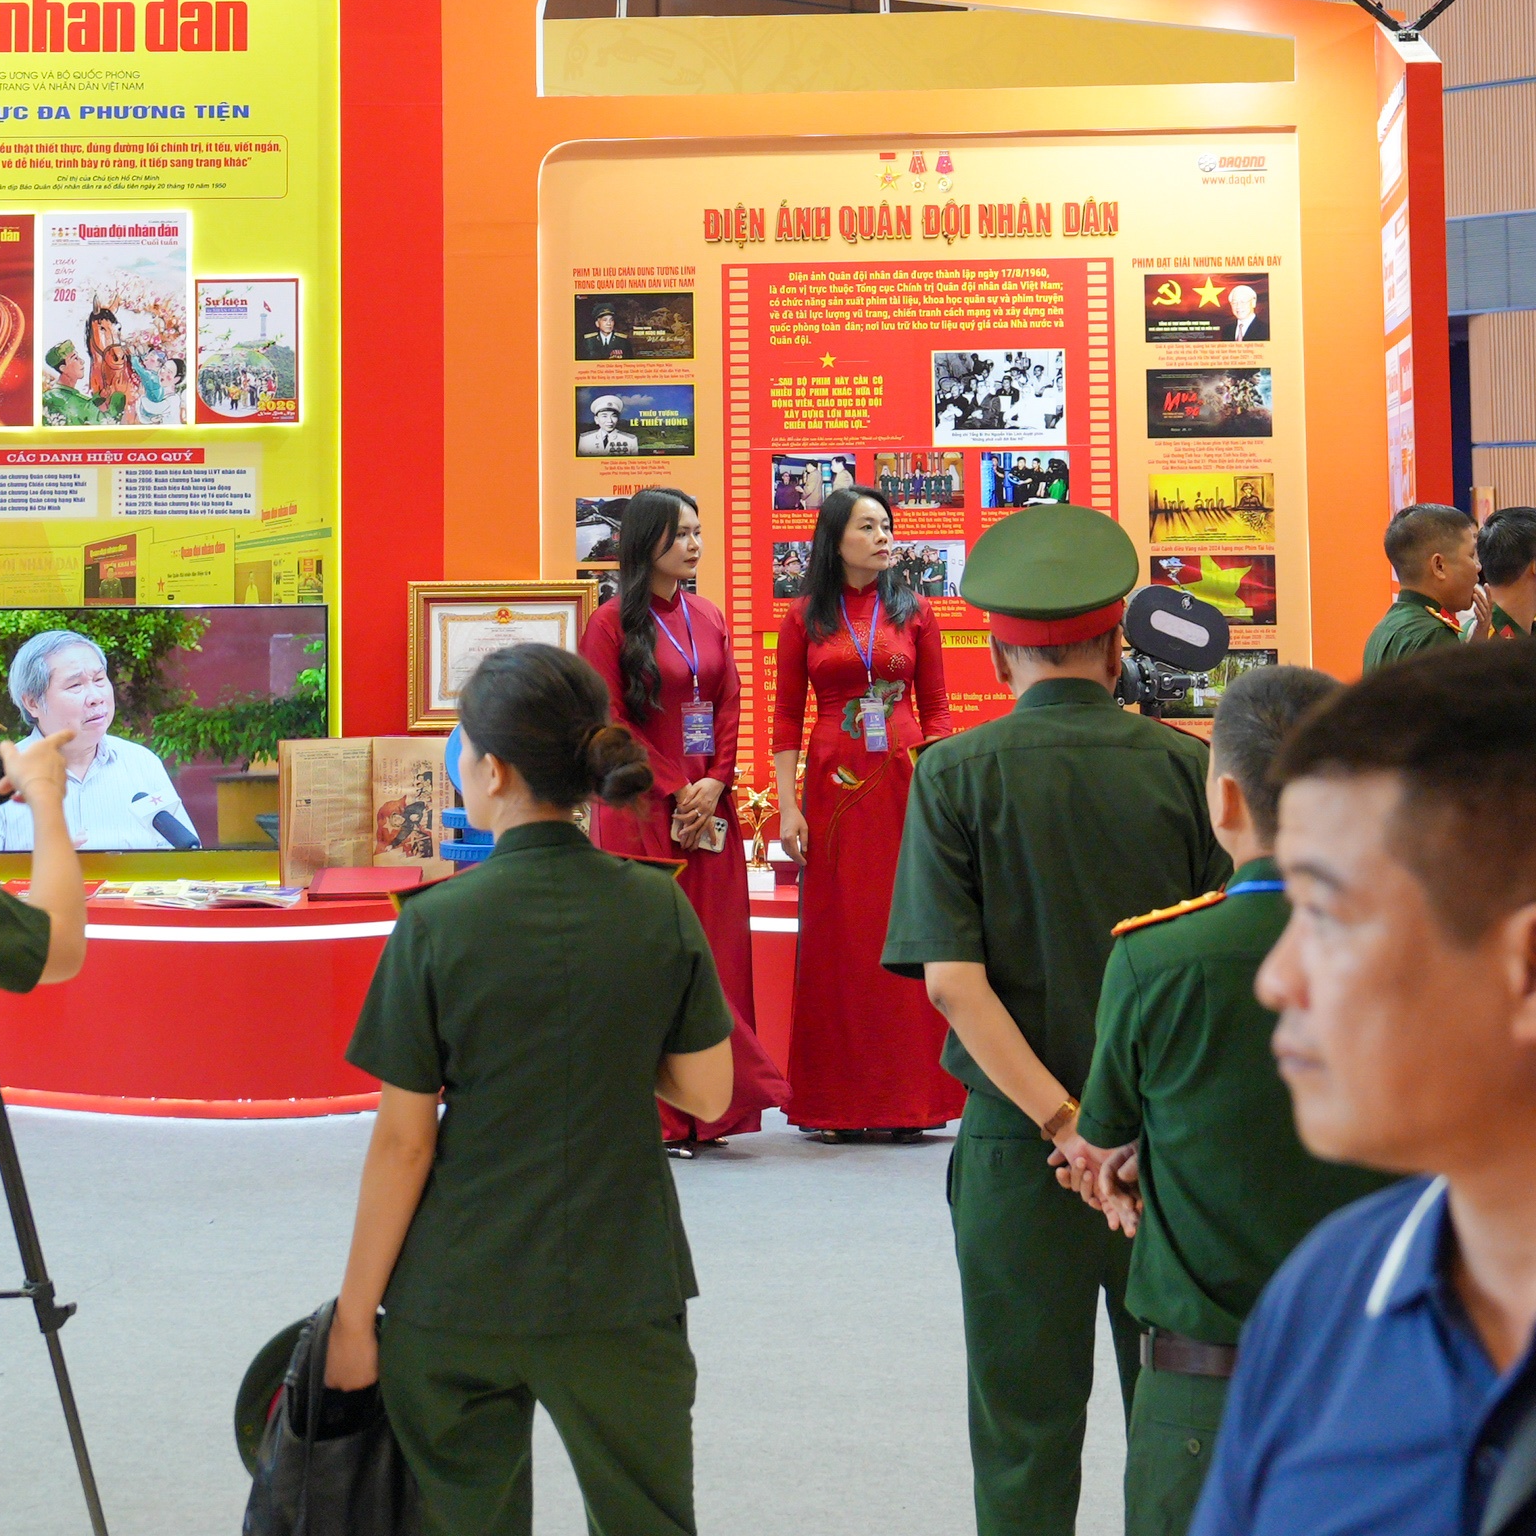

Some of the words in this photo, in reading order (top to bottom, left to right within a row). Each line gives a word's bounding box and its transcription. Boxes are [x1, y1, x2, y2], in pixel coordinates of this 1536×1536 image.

[37, 105, 71, 119] ĐA
[79, 105, 185, 119] PHƯƠNG
[194, 101, 250, 121] TIỆN
[1202, 175, 1265, 186] www.daqd.vn
[79, 224, 107, 240] Quân
[109, 224, 127, 240] đội
[128, 224, 156, 238] nhân
[158, 223, 178, 237] dân
[703, 202, 766, 250] ĐIỆN
[775, 199, 831, 243] ẢNH
[838, 199, 912, 245] QUÂN
[921, 199, 971, 246] ĐỘI
[978, 198, 1051, 239] NHÂN
[1063, 199, 1118, 237] DÂN
[788, 271, 808, 282] Điện
[810, 271, 826, 280] ảnh
[828, 271, 851, 281] Quân
[852, 270, 867, 281] đội
[869, 270, 890, 279] nhân
[892, 269, 909, 279] dân
[910, 270, 934, 280] được
[935, 269, 960, 278] thành
[962, 268, 976, 280] lập
[977, 268, 999, 280] ngày
[1001, 267, 1049, 278] 17/8/1960,
[769, 285, 777, 294] là
[779, 284, 797, 294] đơn
[799, 284, 806, 295] vị
[809, 285, 827, 295] trực
[829, 283, 854, 294] thuộc
[855, 282, 877, 294] Tổng
[879, 285, 894, 294] cục
[896, 282, 922, 292] Chính
[923, 282, 934, 293] trị
[936, 281, 959, 292] Quân
[961, 281, 976, 292] đội
[977, 281, 1000, 290] nhân
[1001, 280, 1018, 290] dân
[1019, 280, 1038, 292] Việt
[1040, 280, 1063, 291] Nam;
[53, 289, 76, 302] 2026
[257, 400, 296, 411] 2026
[6, 450, 36, 462] CÁC
[39, 453, 82, 462] DANH
[86, 450, 123, 464] HIỆU
[127, 452, 157, 461] CAO
[161, 449, 193, 462] QUÝ
[950, 635, 976, 645] TRONG
